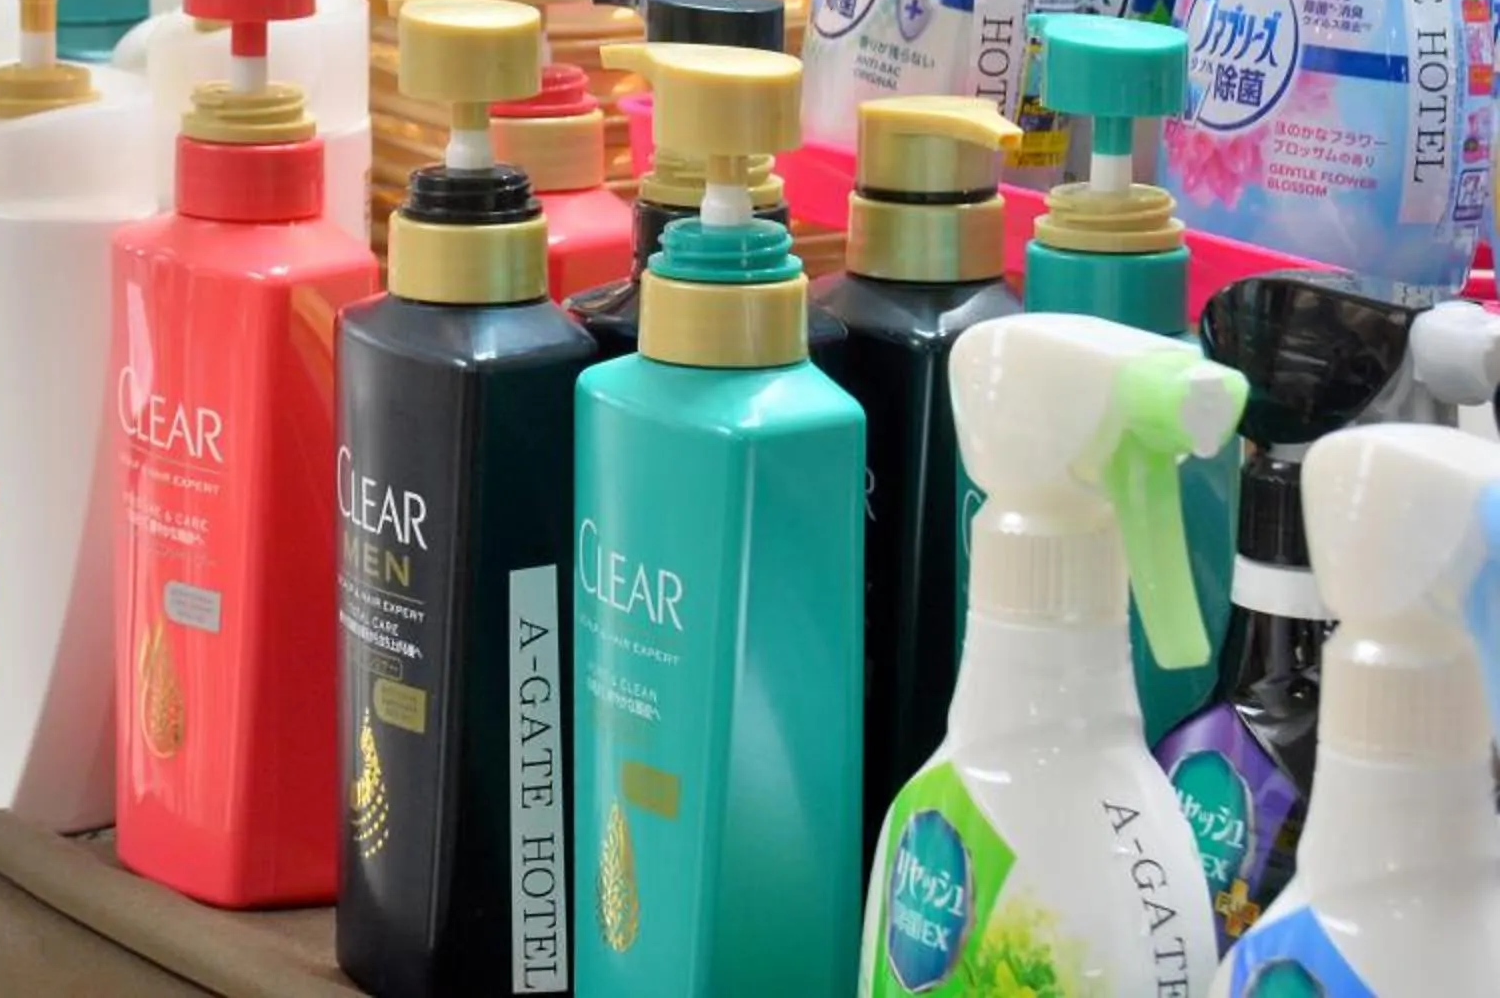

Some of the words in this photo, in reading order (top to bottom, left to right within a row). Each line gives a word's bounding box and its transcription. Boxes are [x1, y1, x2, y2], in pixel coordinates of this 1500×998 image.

[975, 15, 1013, 115] HOT
[1214, 63, 1266, 107] 除菌
[1413, 27, 1449, 183] HOTEL
[1267, 176, 1328, 197] BLOSSOM
[1269, 163, 1317, 182] GENTLE
[1321, 170, 1378, 190] FLOWER
[117, 364, 225, 463] CLEAR
[173, 474, 221, 495] EXPERT
[337, 444, 428, 551] CLEAR
[343, 529, 410, 587] MEN
[578, 517, 683, 631] CLEAR
[372, 616, 399, 637] CARE
[383, 601, 426, 623] EXPERT
[633, 642, 680, 666] EXPERT
[518, 617, 554, 809] A-GATE
[620, 678, 658, 703] CLEAN
[520, 833, 558, 990] HOTEL
[1102, 800, 1189, 998] A-GATE
